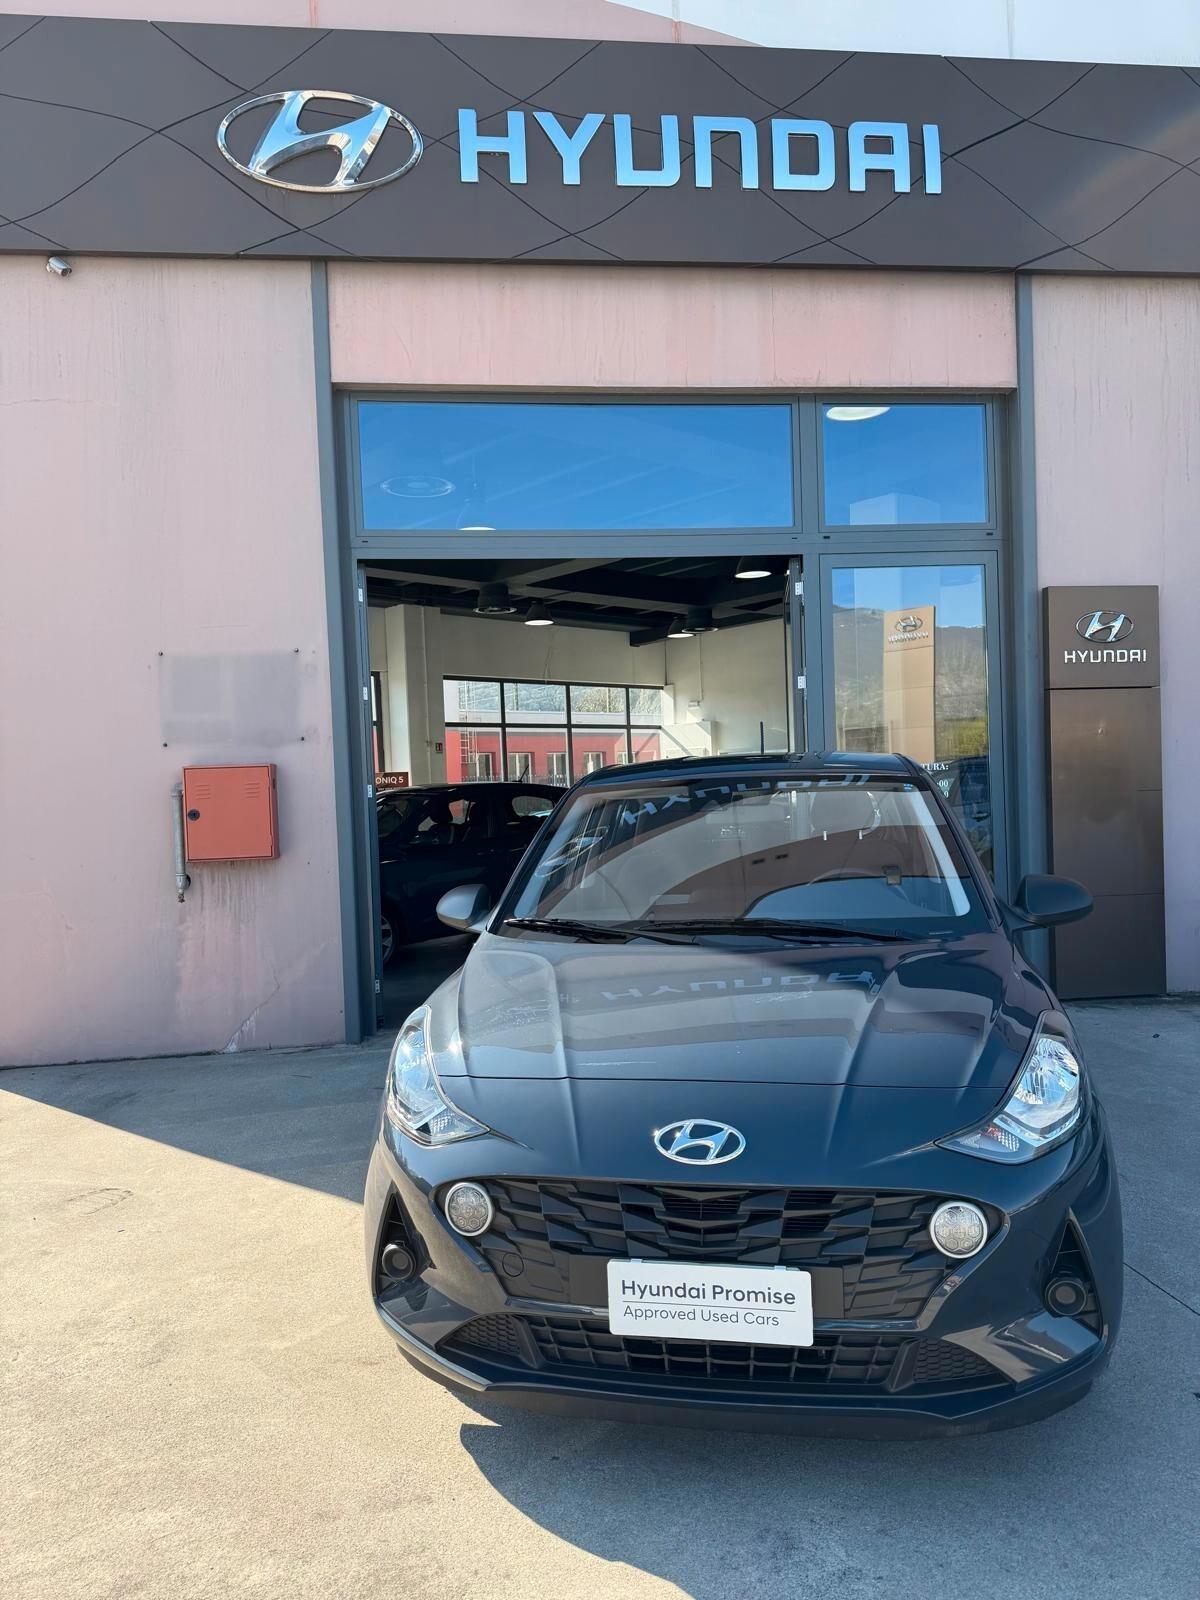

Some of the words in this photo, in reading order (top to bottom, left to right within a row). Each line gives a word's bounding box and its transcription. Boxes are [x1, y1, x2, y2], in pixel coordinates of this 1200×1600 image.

[457, 108, 942, 195] HYUNDAI
[1064, 649, 1147, 664] HYUNDAI
[376, 776, 397, 784] ONIQ
[621, 1279, 706, 1300] Hyundai
[712, 1284, 796, 1305] Promise
[623, 1305, 696, 1321] Approved
[701, 1309, 739, 1324] Used
[743, 1312, 779, 1326] Cars
